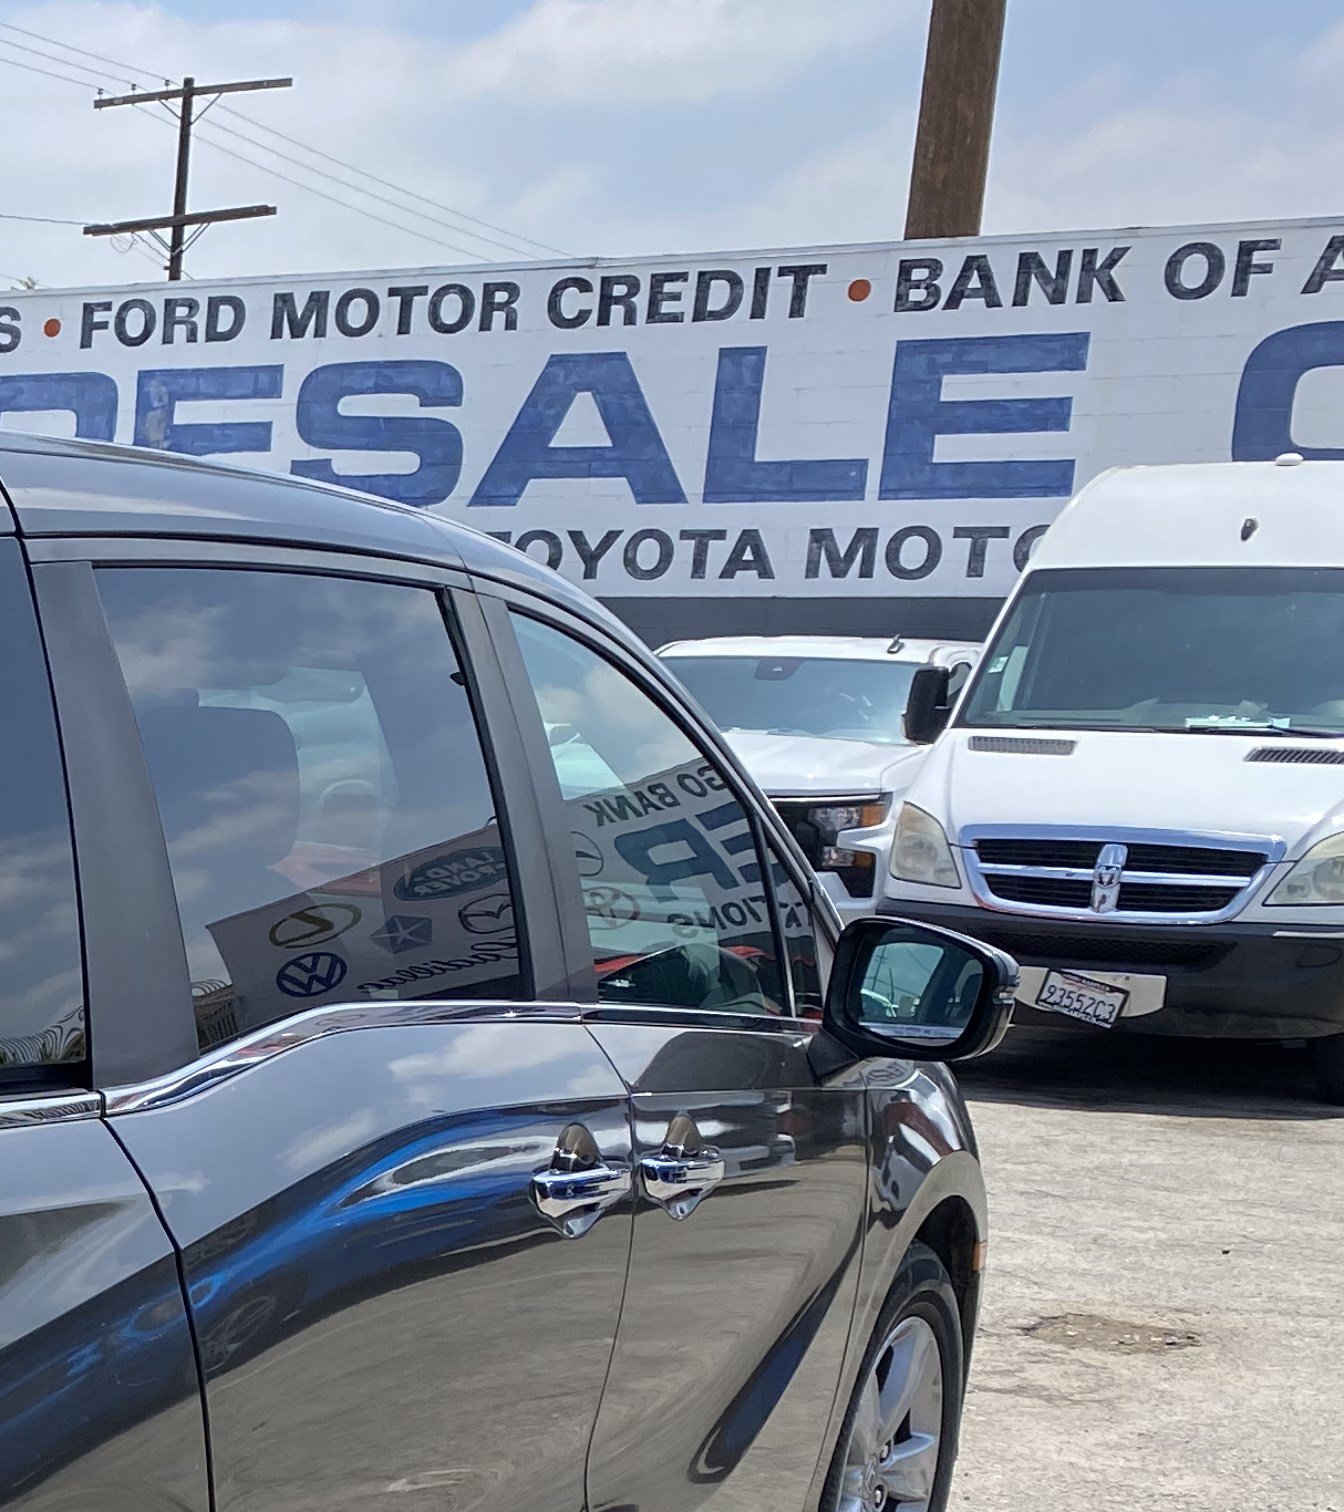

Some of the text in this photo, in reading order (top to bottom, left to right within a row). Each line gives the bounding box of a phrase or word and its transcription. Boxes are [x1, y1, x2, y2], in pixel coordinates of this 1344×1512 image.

[79, 294, 247, 349] FORD
[270, 281, 521, 340] MOTOR
[547, 263, 828, 330] CREDIT
[894, 246, 1133, 312] BANK
[1164, 237, 1283, 301] OF
